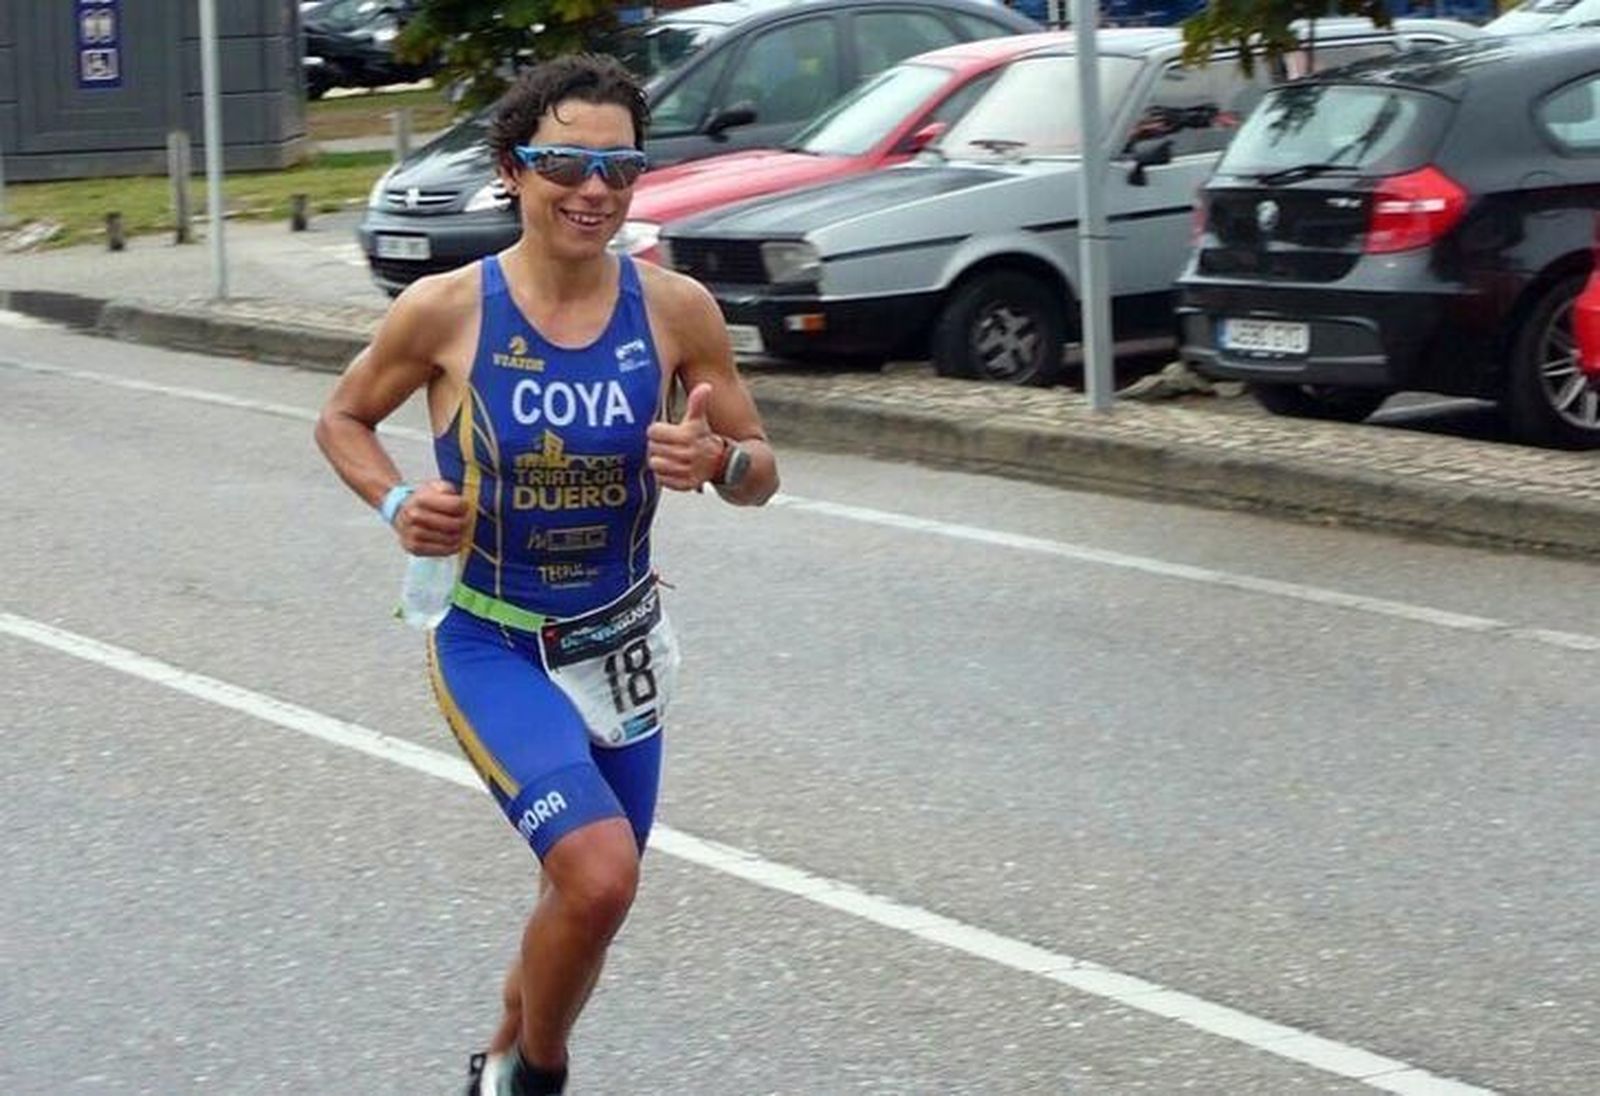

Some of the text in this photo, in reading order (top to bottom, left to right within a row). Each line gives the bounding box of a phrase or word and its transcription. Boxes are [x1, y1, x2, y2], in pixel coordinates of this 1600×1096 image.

[512, 379, 635, 427] COYA
[512, 484, 628, 511] DUERO
[604, 639, 658, 715] 18
